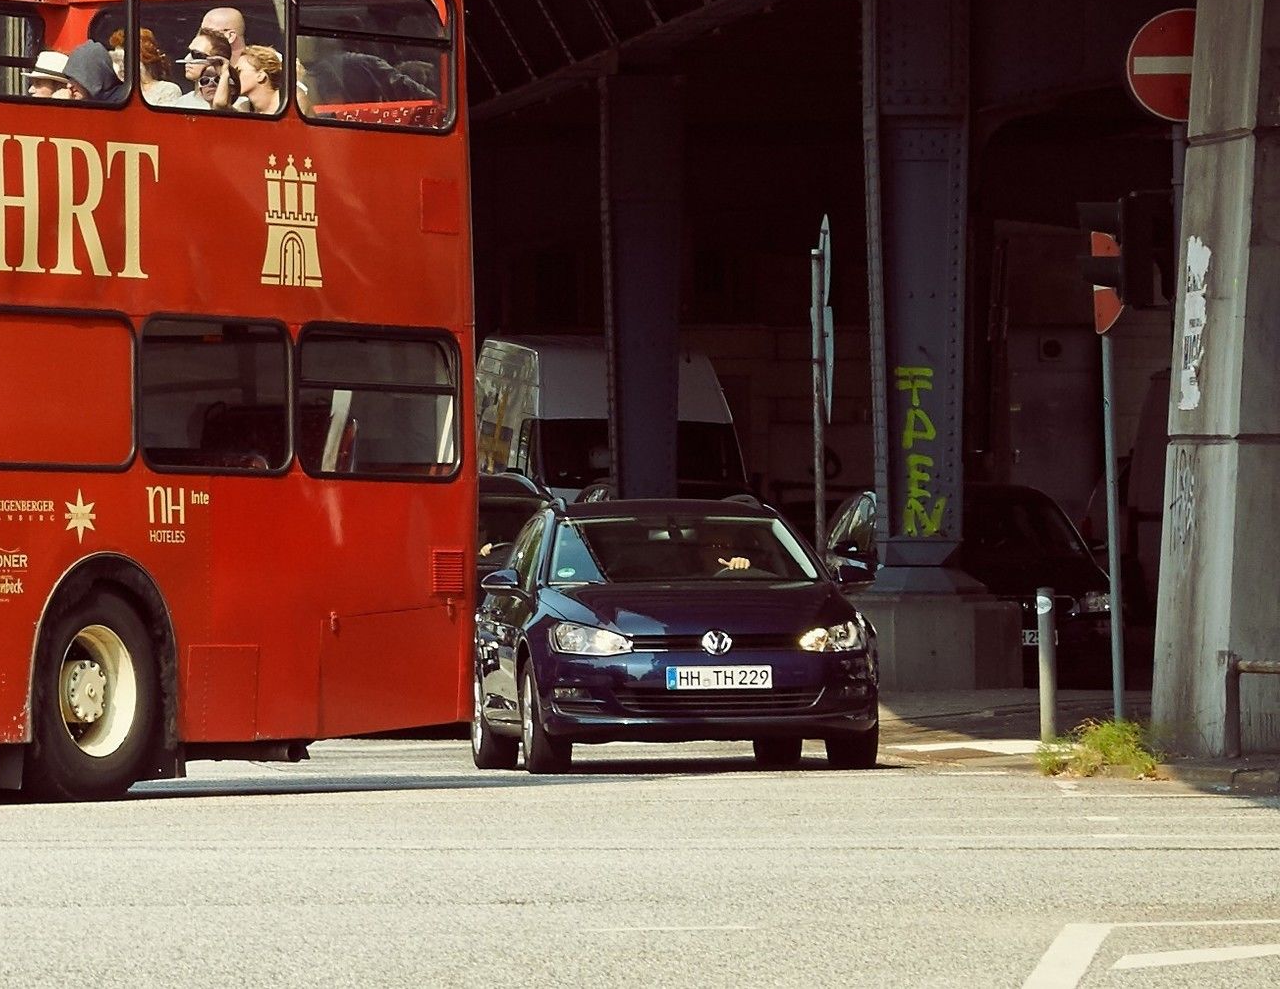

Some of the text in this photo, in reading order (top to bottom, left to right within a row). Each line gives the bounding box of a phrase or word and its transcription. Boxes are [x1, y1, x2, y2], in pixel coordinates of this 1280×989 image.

[149, 530, 186, 543] HOTELES
[679, 670, 769, 686] HH TH 229
